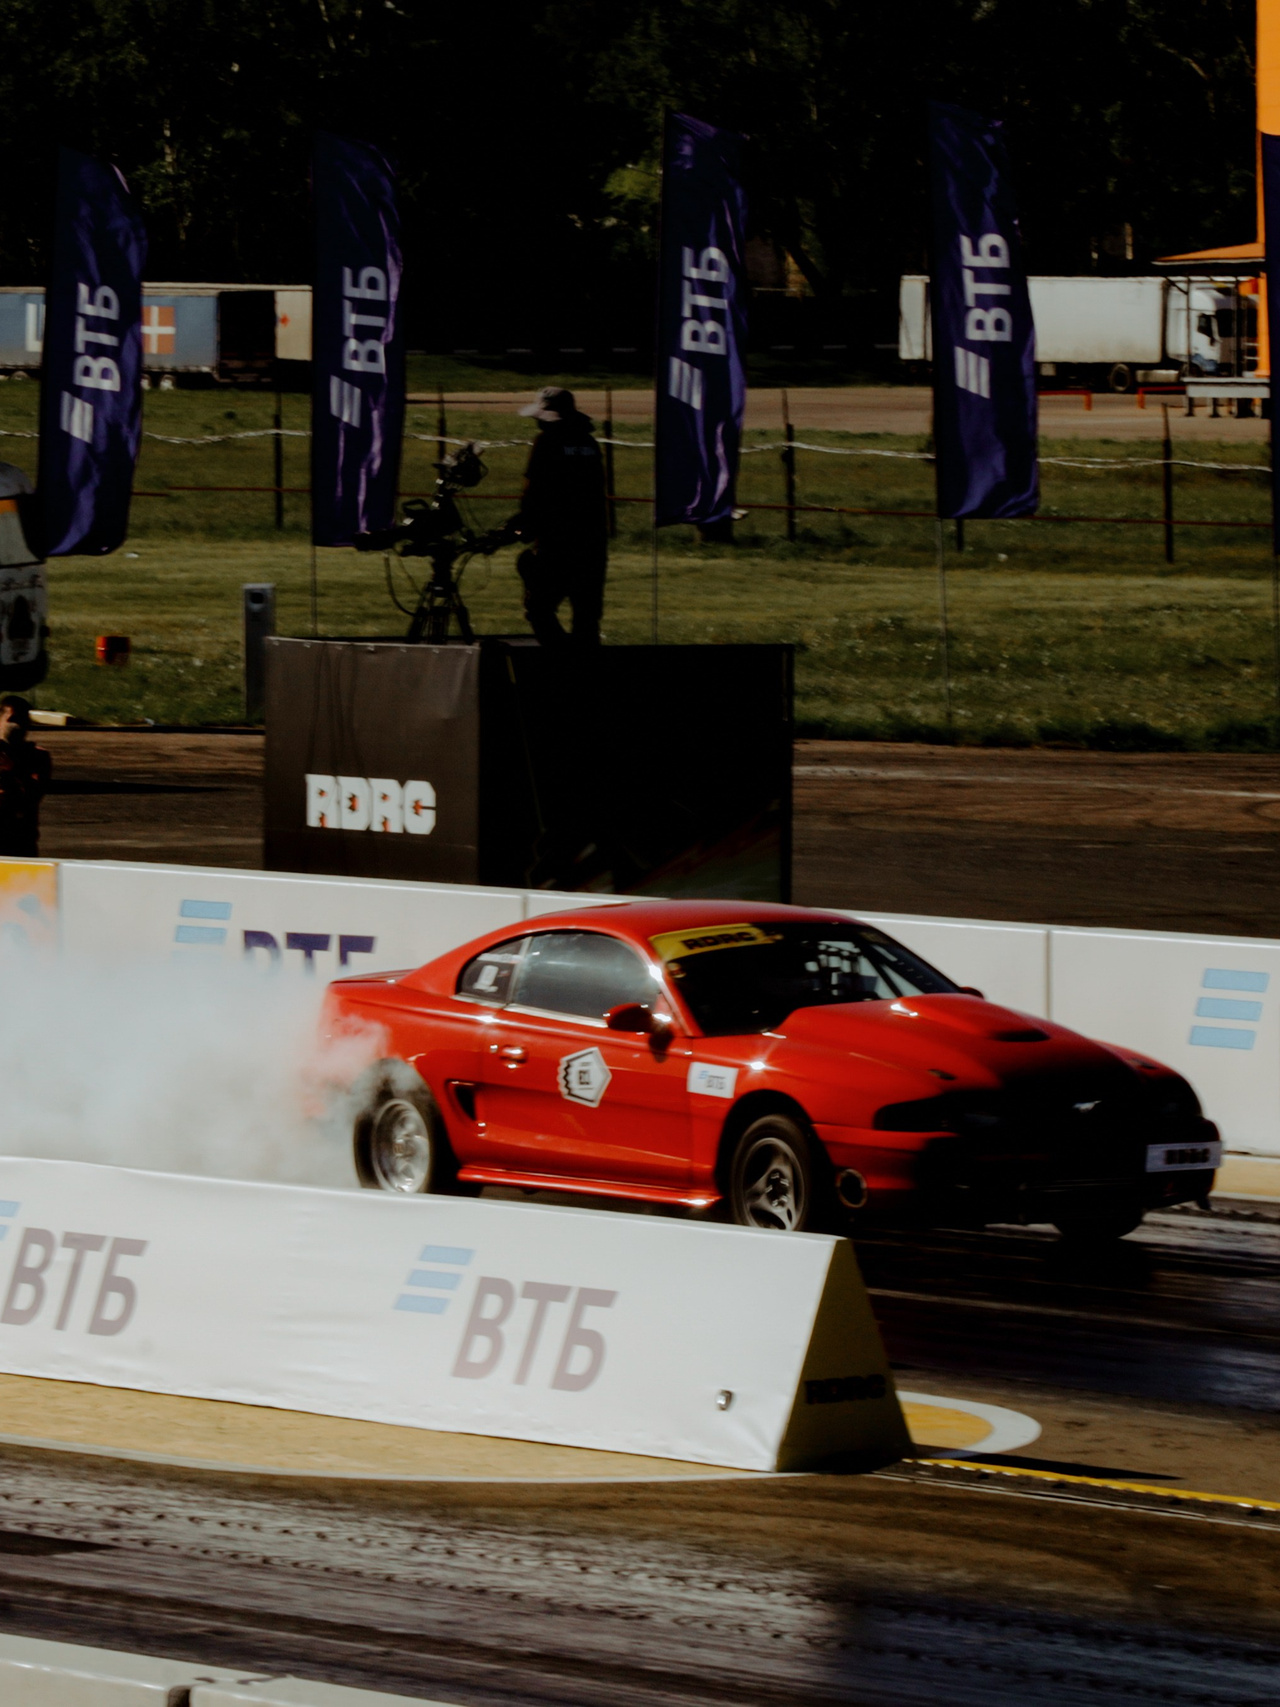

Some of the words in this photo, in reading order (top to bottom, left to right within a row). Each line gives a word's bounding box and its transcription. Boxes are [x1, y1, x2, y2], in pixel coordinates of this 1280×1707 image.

[74, 282, 121, 392] ВТБ
[342, 265, 387, 374] ВТБ
[681, 246, 729, 355] ВТБ
[962, 232, 1013, 343] ВТБ
[305, 773, 437, 836] RDRC
[681, 931, 756, 950] RDRC
[0, 1228, 149, 1337] ВТБ
[454, 1277, 620, 1393] ВТБ
